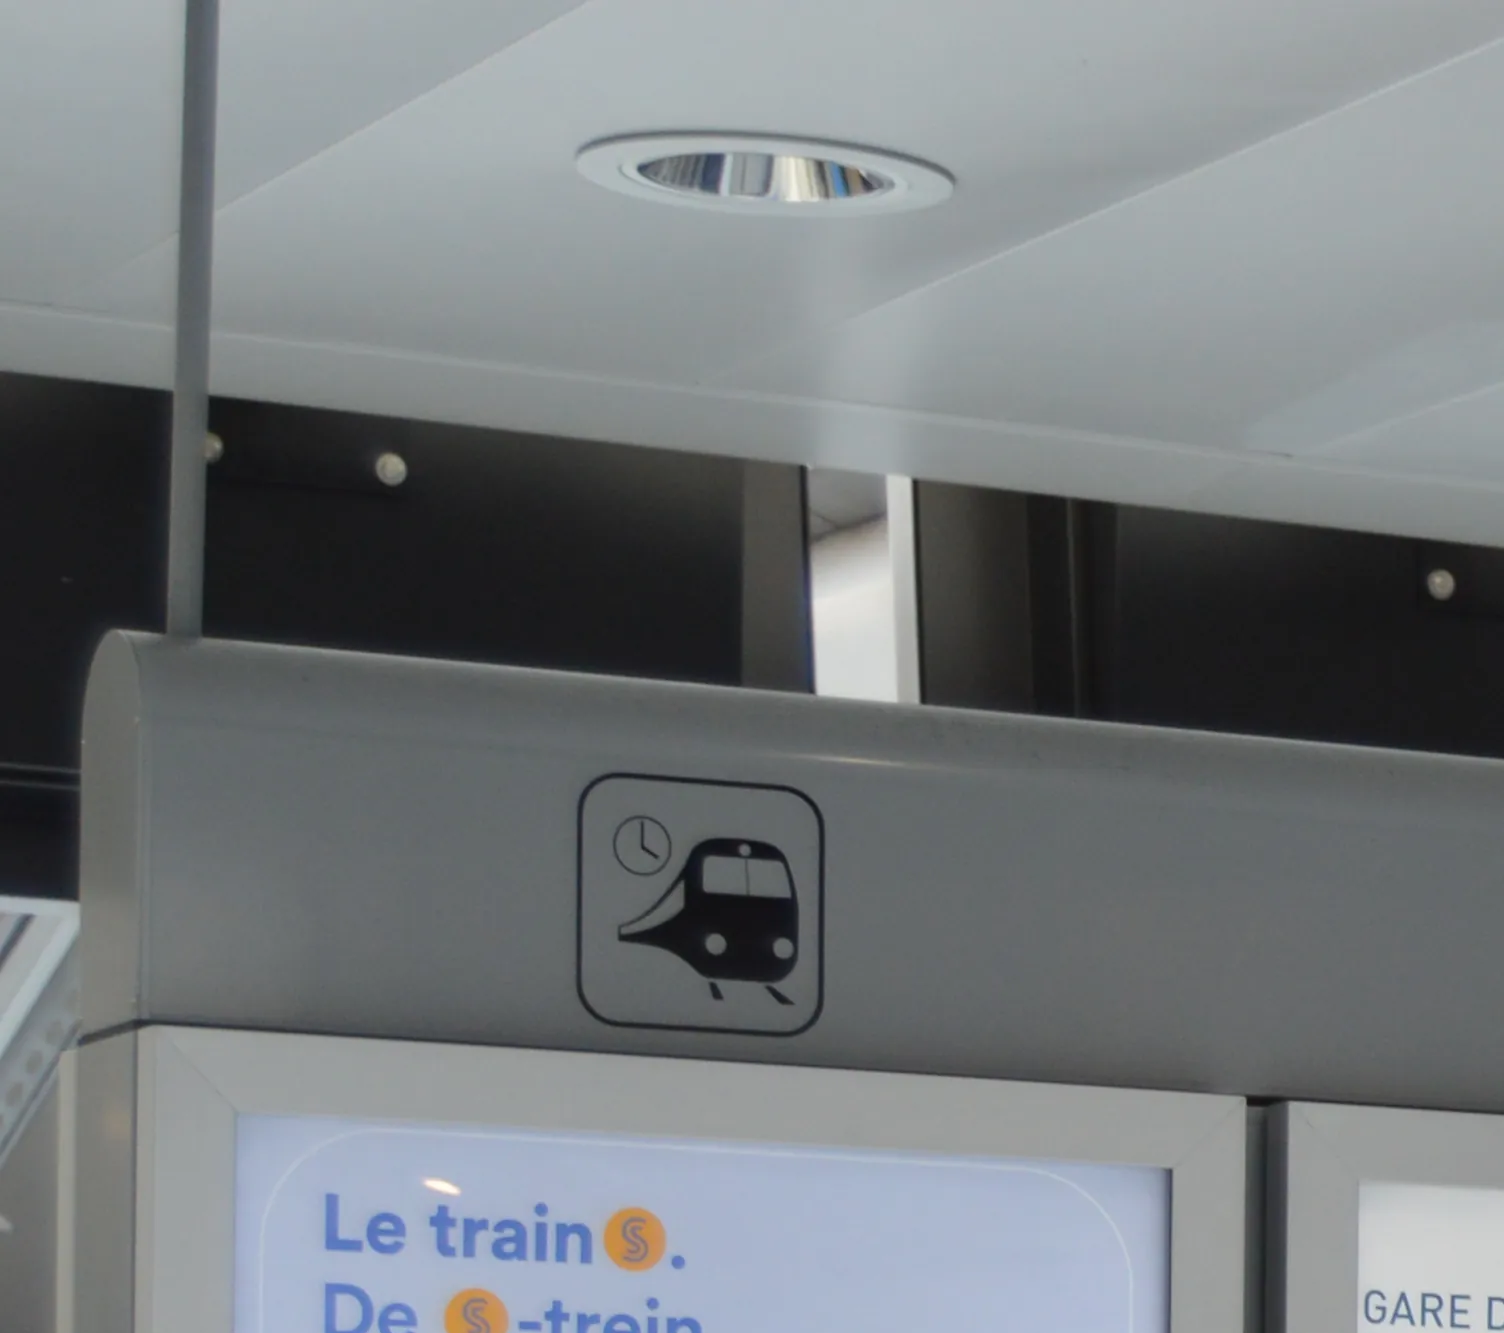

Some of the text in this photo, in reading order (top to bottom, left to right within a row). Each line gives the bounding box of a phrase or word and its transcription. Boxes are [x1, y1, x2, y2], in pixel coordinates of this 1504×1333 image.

[325, 1193, 407, 1255] Le
[429, 1202, 593, 1264] train
[1362, 1289, 1472, 1330] GARE
